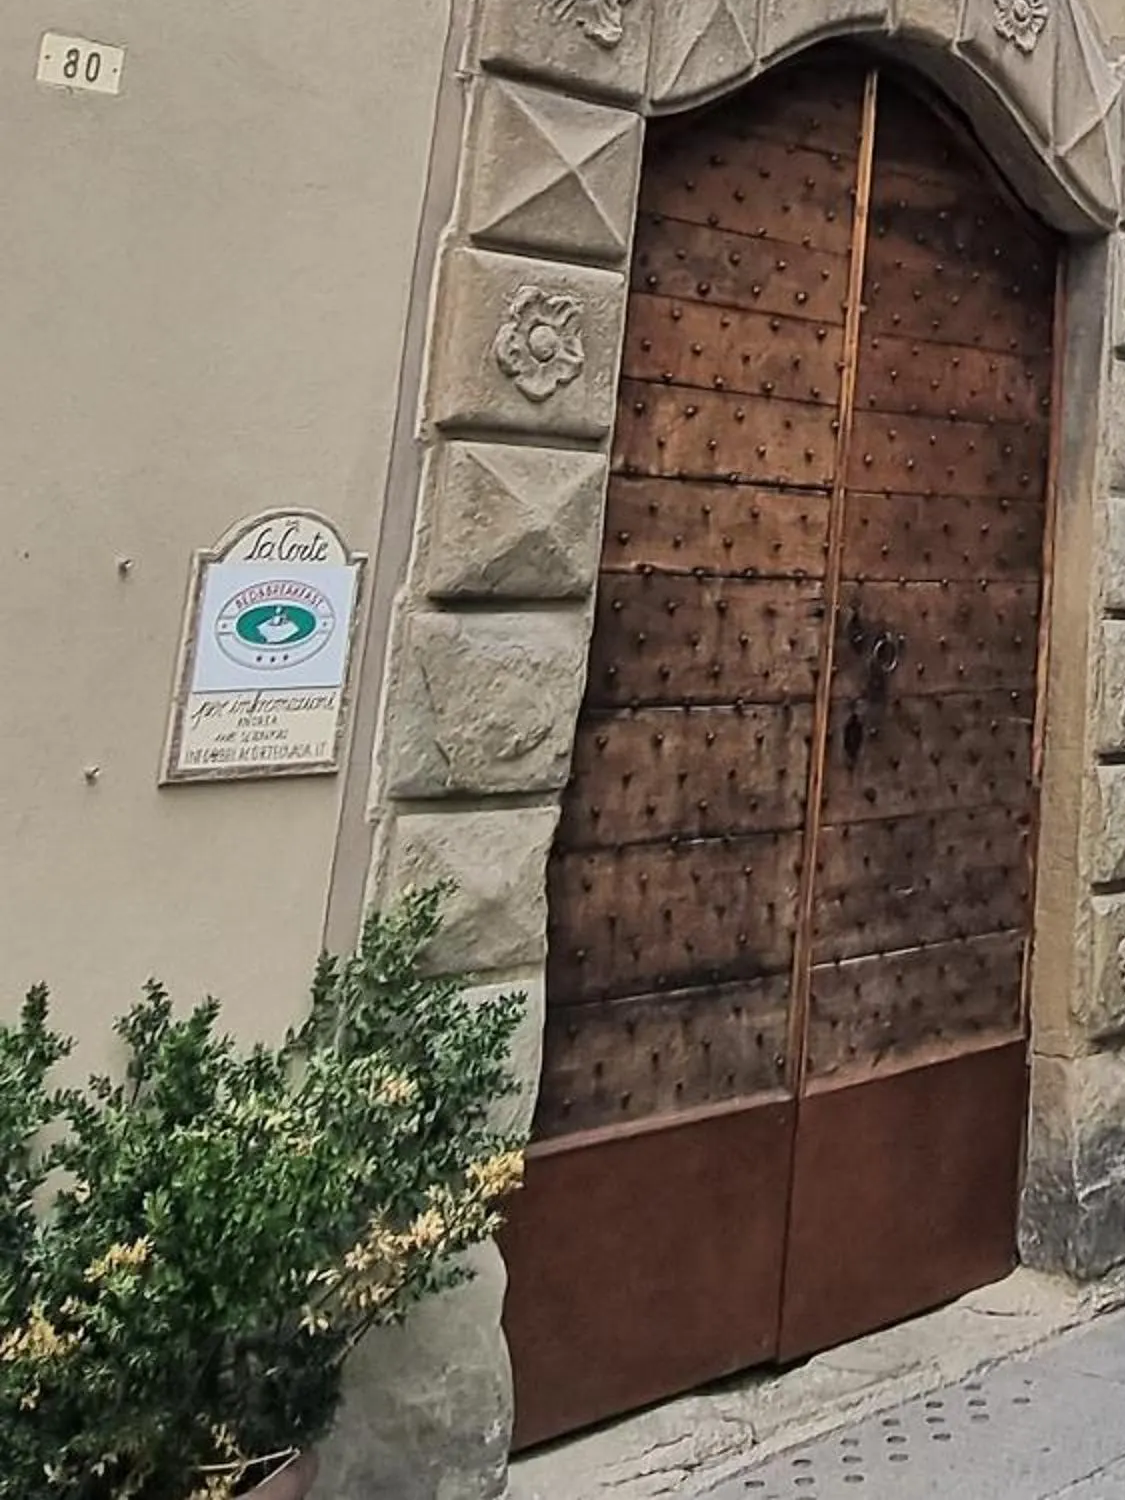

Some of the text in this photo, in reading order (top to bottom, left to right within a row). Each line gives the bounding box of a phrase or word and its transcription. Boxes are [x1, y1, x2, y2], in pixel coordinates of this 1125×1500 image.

[63, 48, 101, 82] 80
[244, 525, 329, 562] La Corte
